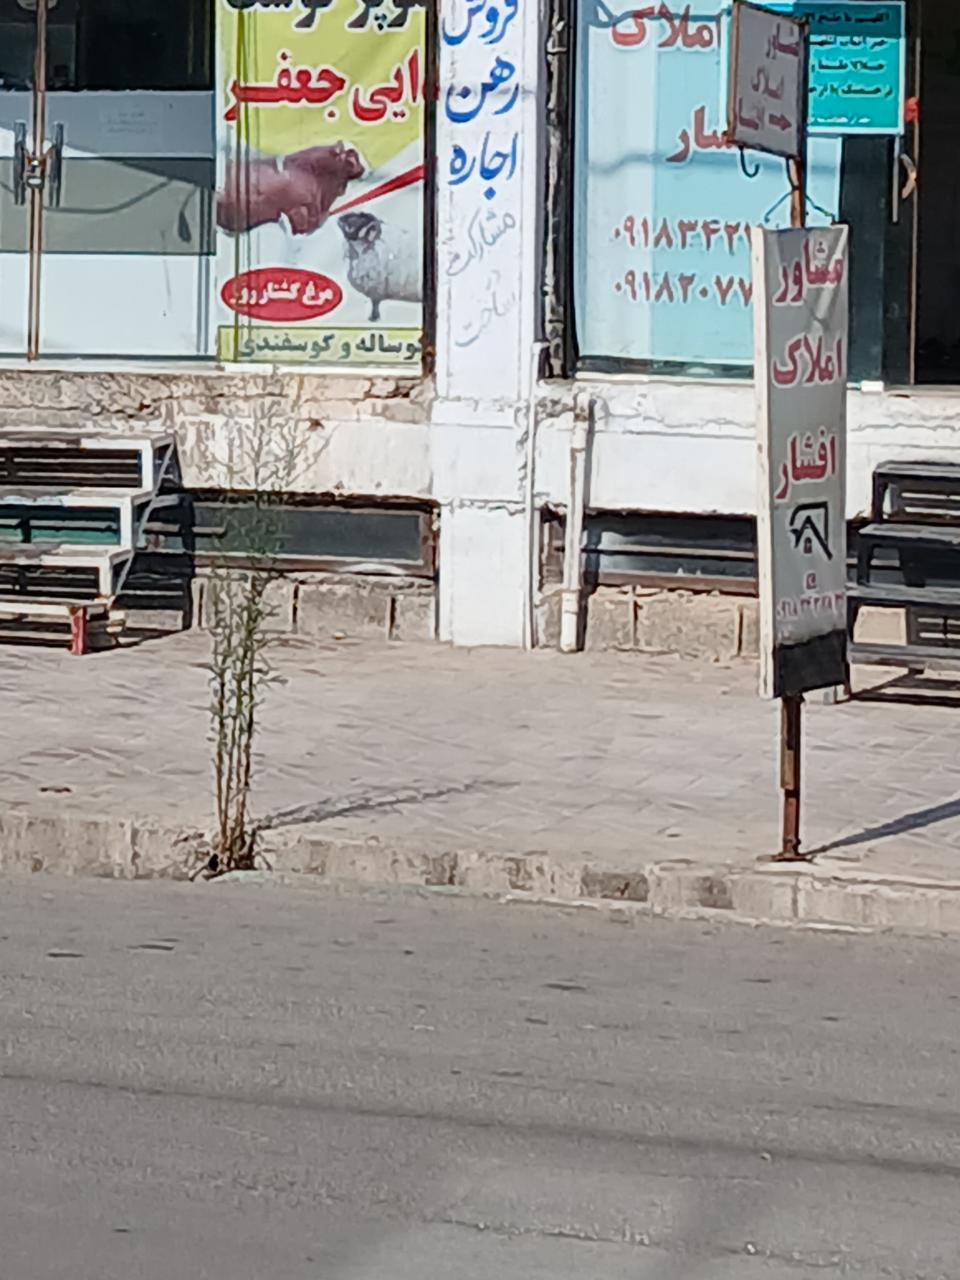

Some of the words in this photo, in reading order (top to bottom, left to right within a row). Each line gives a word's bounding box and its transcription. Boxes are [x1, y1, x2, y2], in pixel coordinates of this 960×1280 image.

[223, 52, 346, 122] جعفر
[444, 55, 519, 123] رهن
[448, 131, 519, 200] اجاره
[774, 429, 837, 502] افشار
